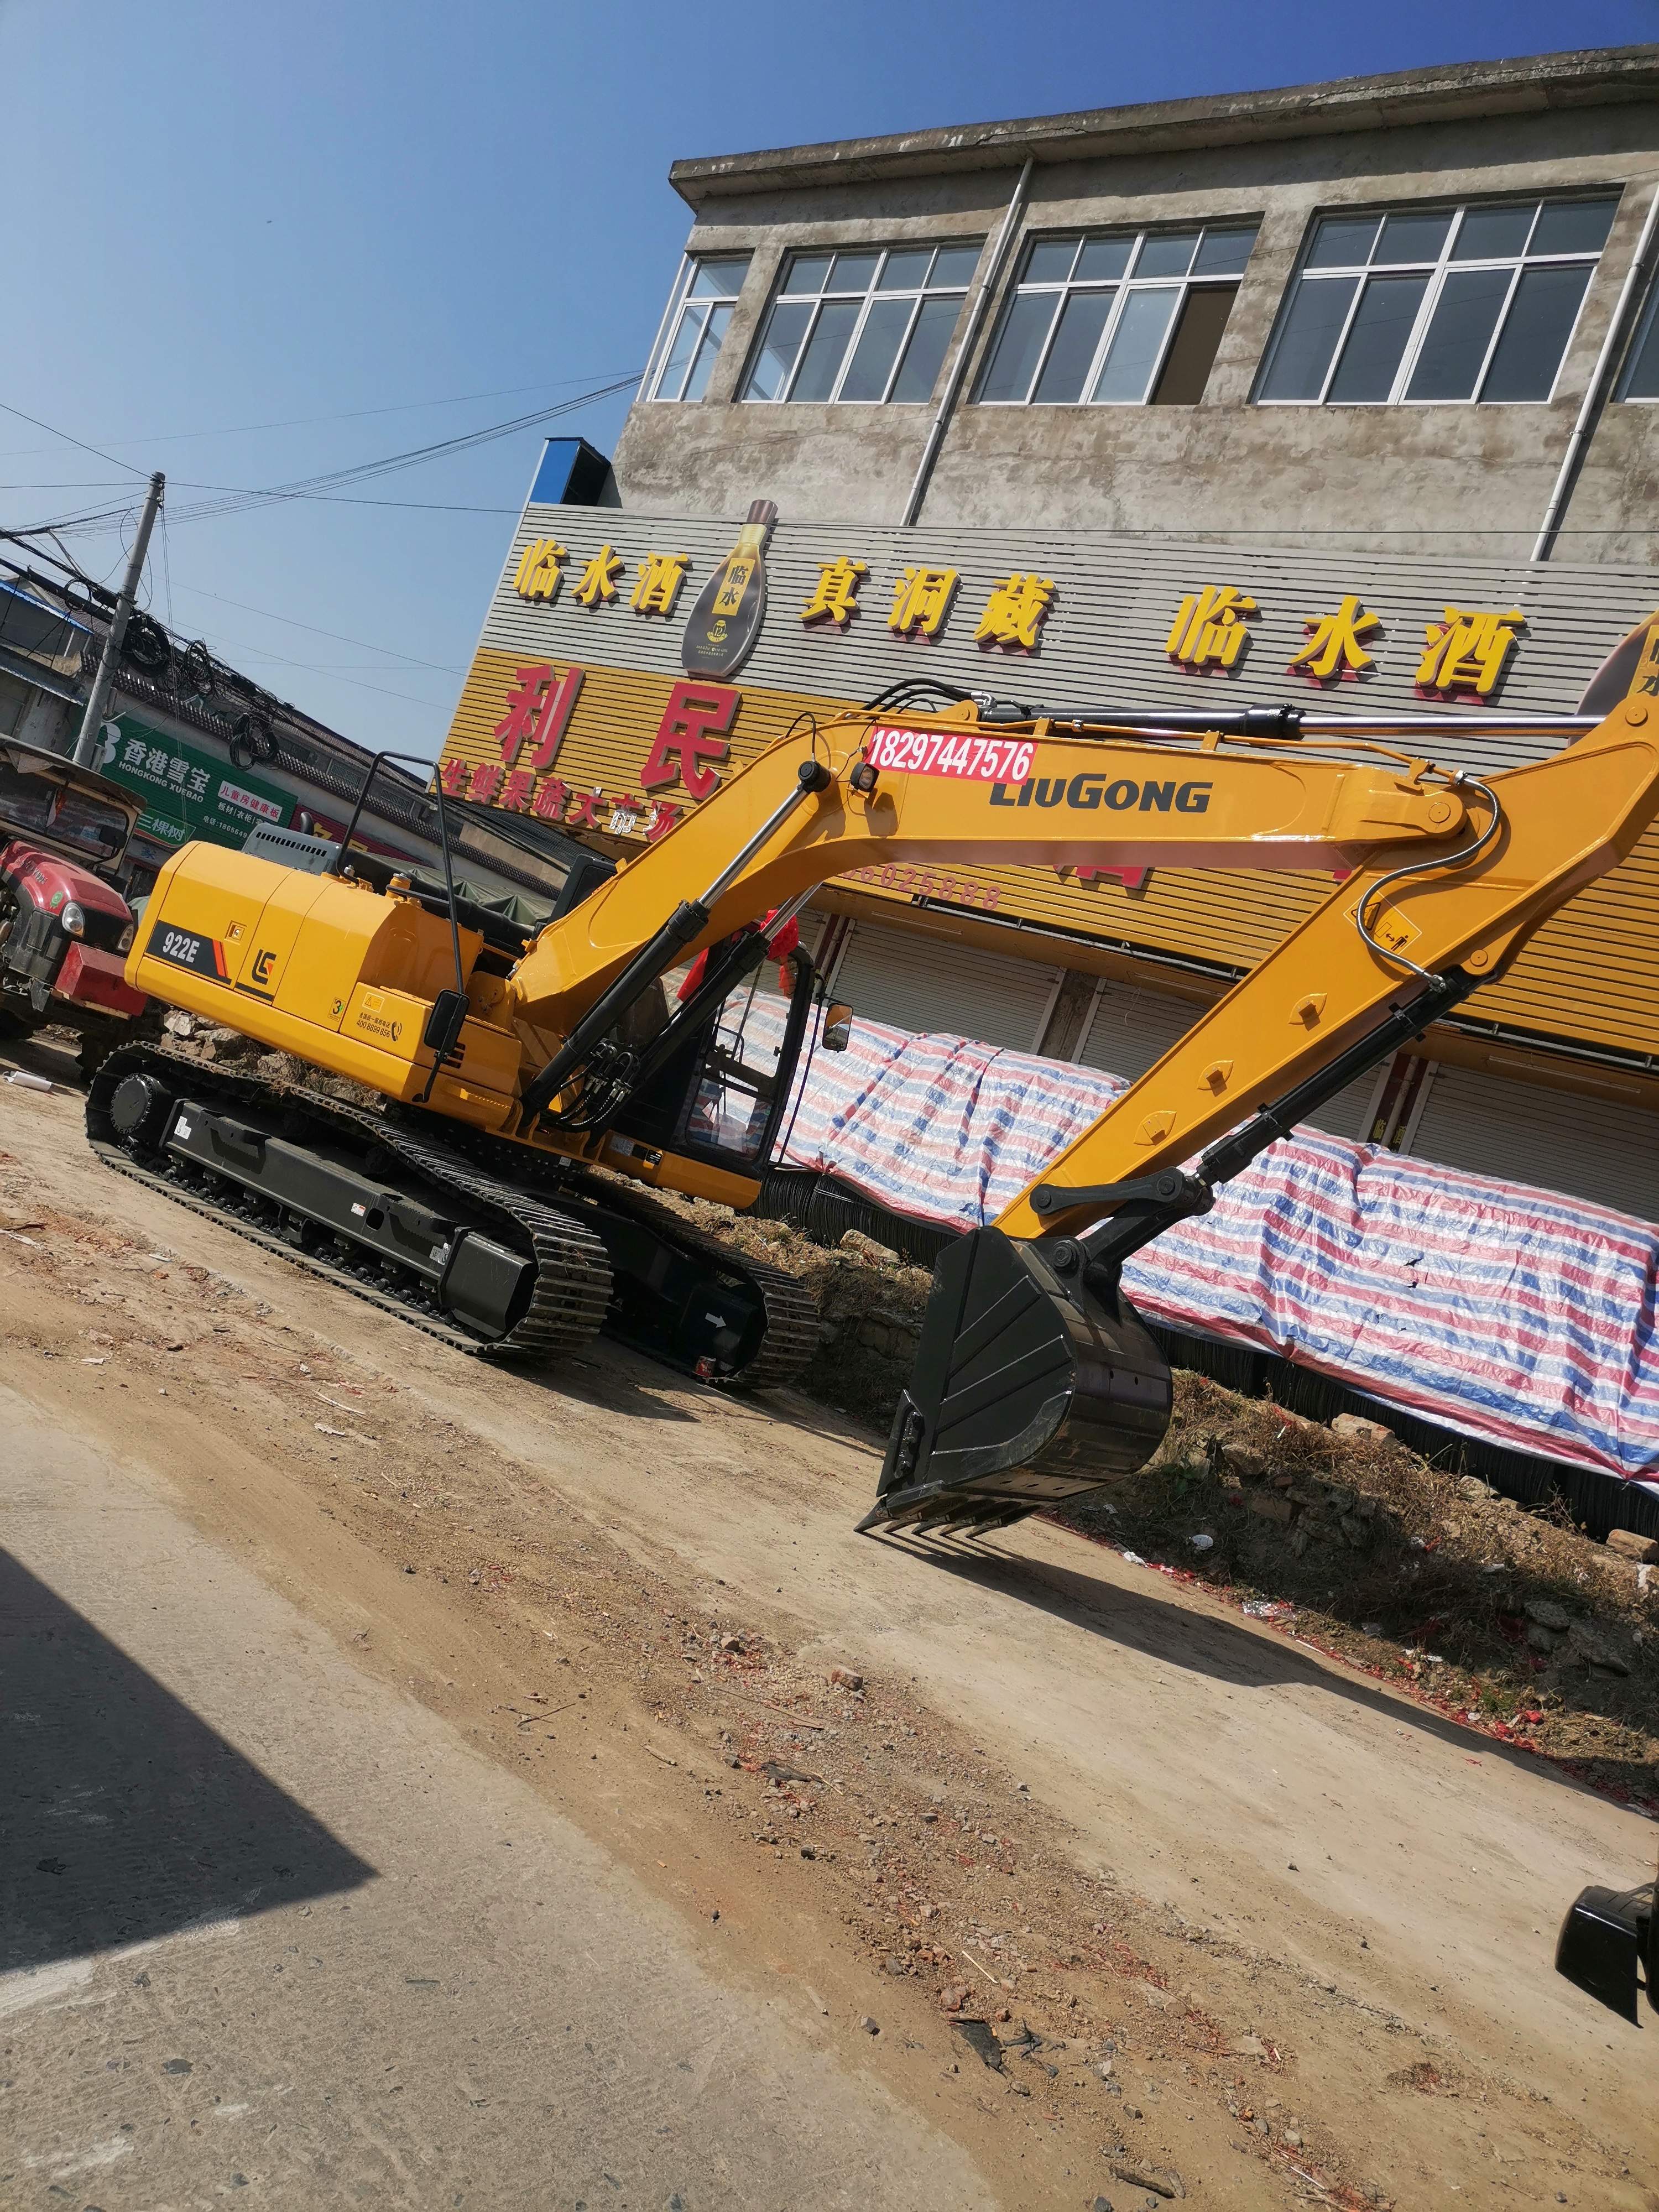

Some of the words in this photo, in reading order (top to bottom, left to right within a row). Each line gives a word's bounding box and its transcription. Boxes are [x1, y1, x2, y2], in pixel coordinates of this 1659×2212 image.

[513, 538, 691, 614] 临水酒
[719, 565, 749, 606] 临水
[800, 556, 1057, 648] 真洞藏
[1165, 586, 1526, 696] 临水酒
[494, 664, 742, 800] 利民
[870, 729, 1034, 780] 18297447576
[118, 761, 168, 787] HONGKONG
[169, 782, 204, 802] XUEBAO
[123, 739, 211, 794] 香港雪宝
[220, 785, 280, 819] 儿童房健康板
[442, 759, 684, 842] 生鲜果蔬大市场
[137, 813, 186, 841] 三棵树
[163, 932, 200, 963] 922E
[356, 1019, 367, 1029] 400
[366, 1022, 380, 1034] 8899
[379, 1027, 391, 1038] 856
